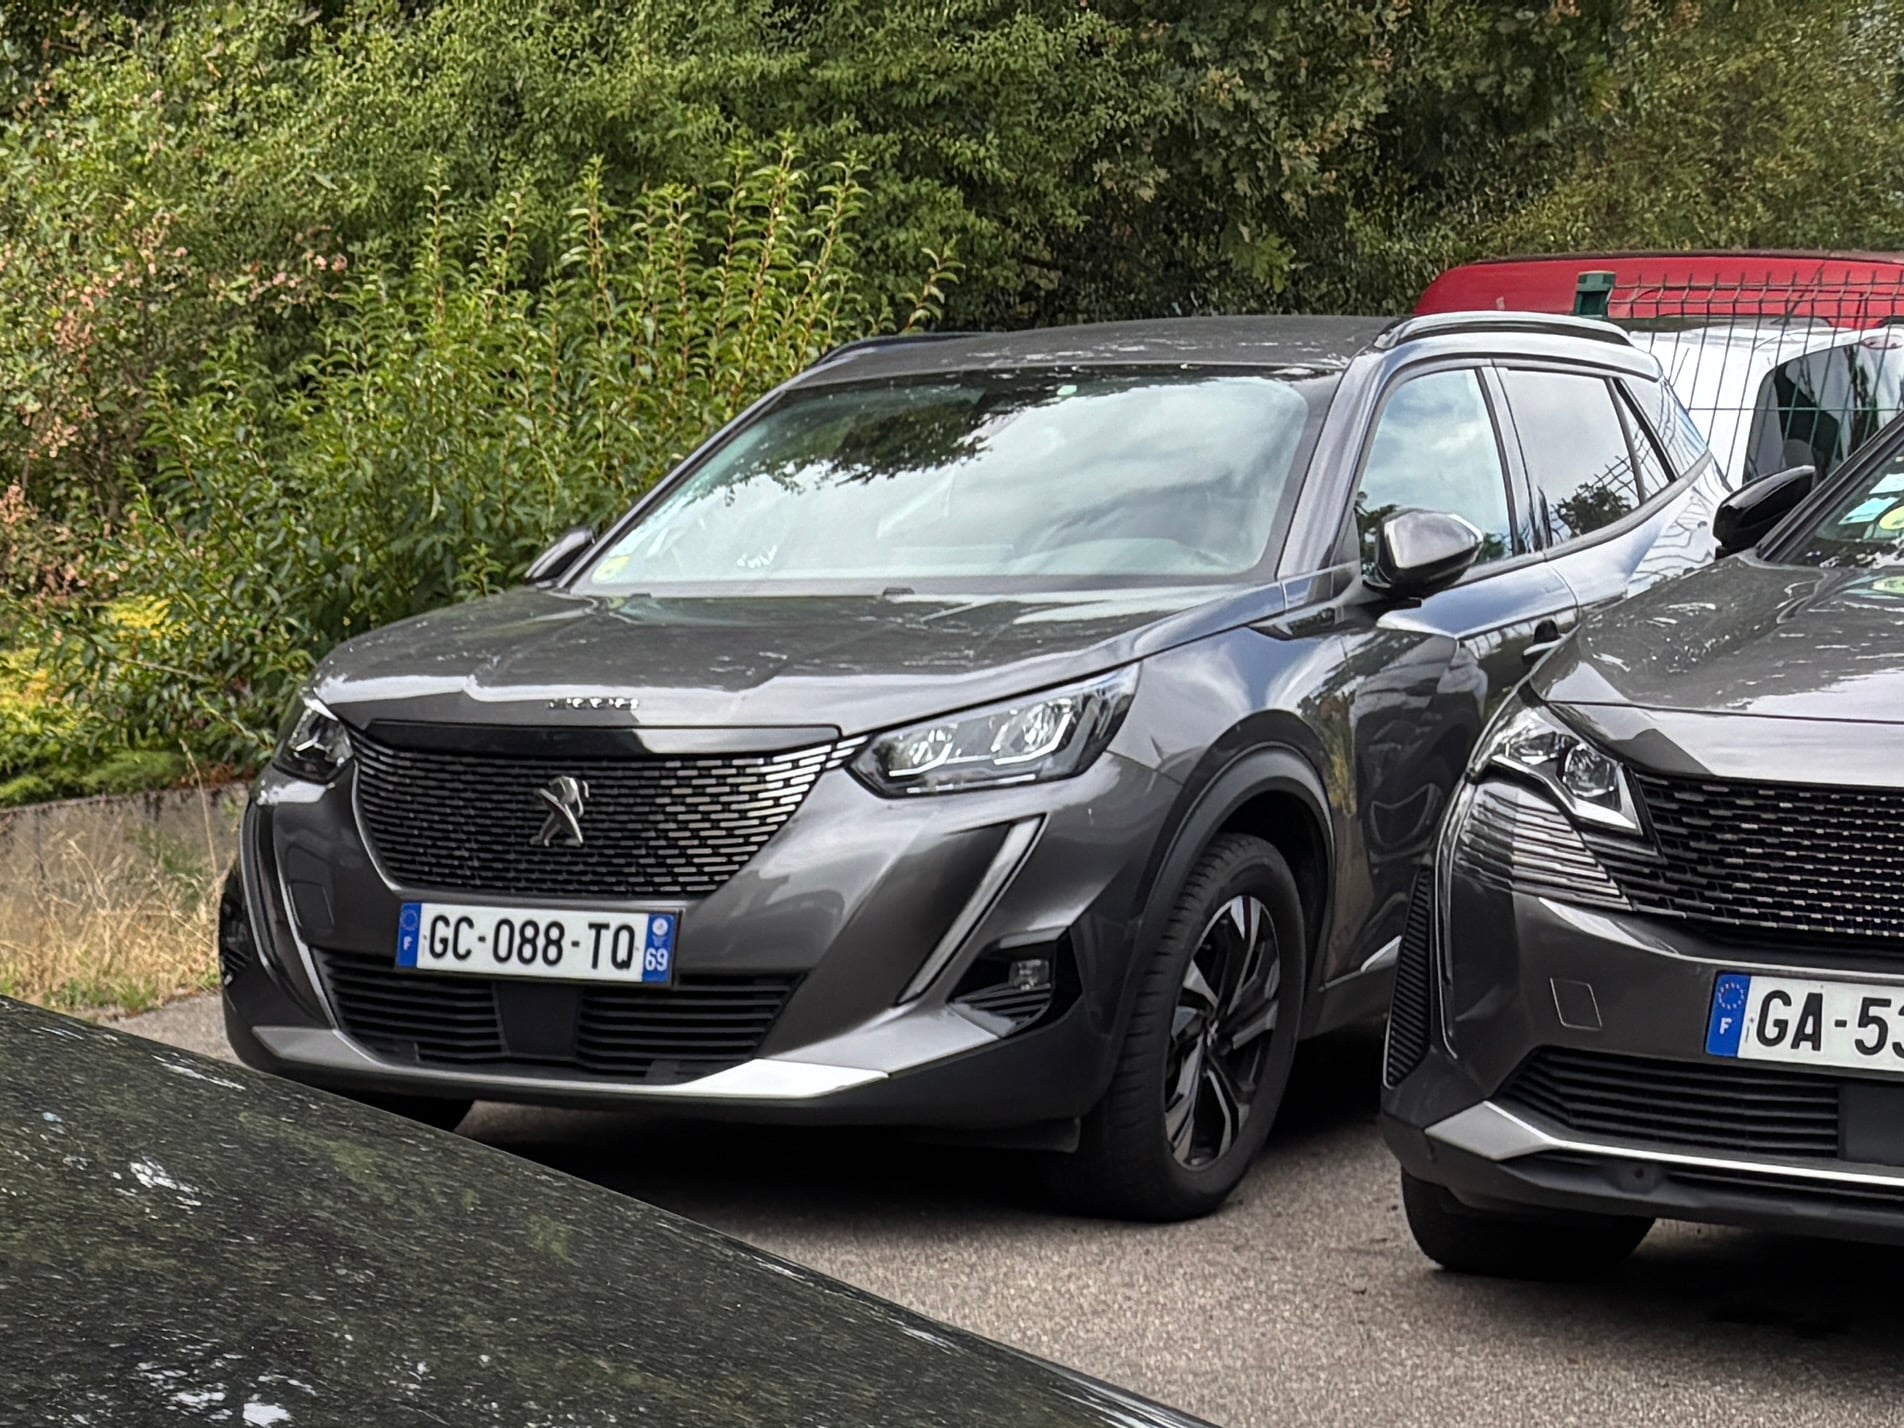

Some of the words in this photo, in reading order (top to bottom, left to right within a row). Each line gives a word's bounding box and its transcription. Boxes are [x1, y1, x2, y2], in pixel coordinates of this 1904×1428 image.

[428, 914, 637, 971] GC-088-TQ
[645, 950, 669, 972] 69
[1719, 1017, 1733, 1036] F
